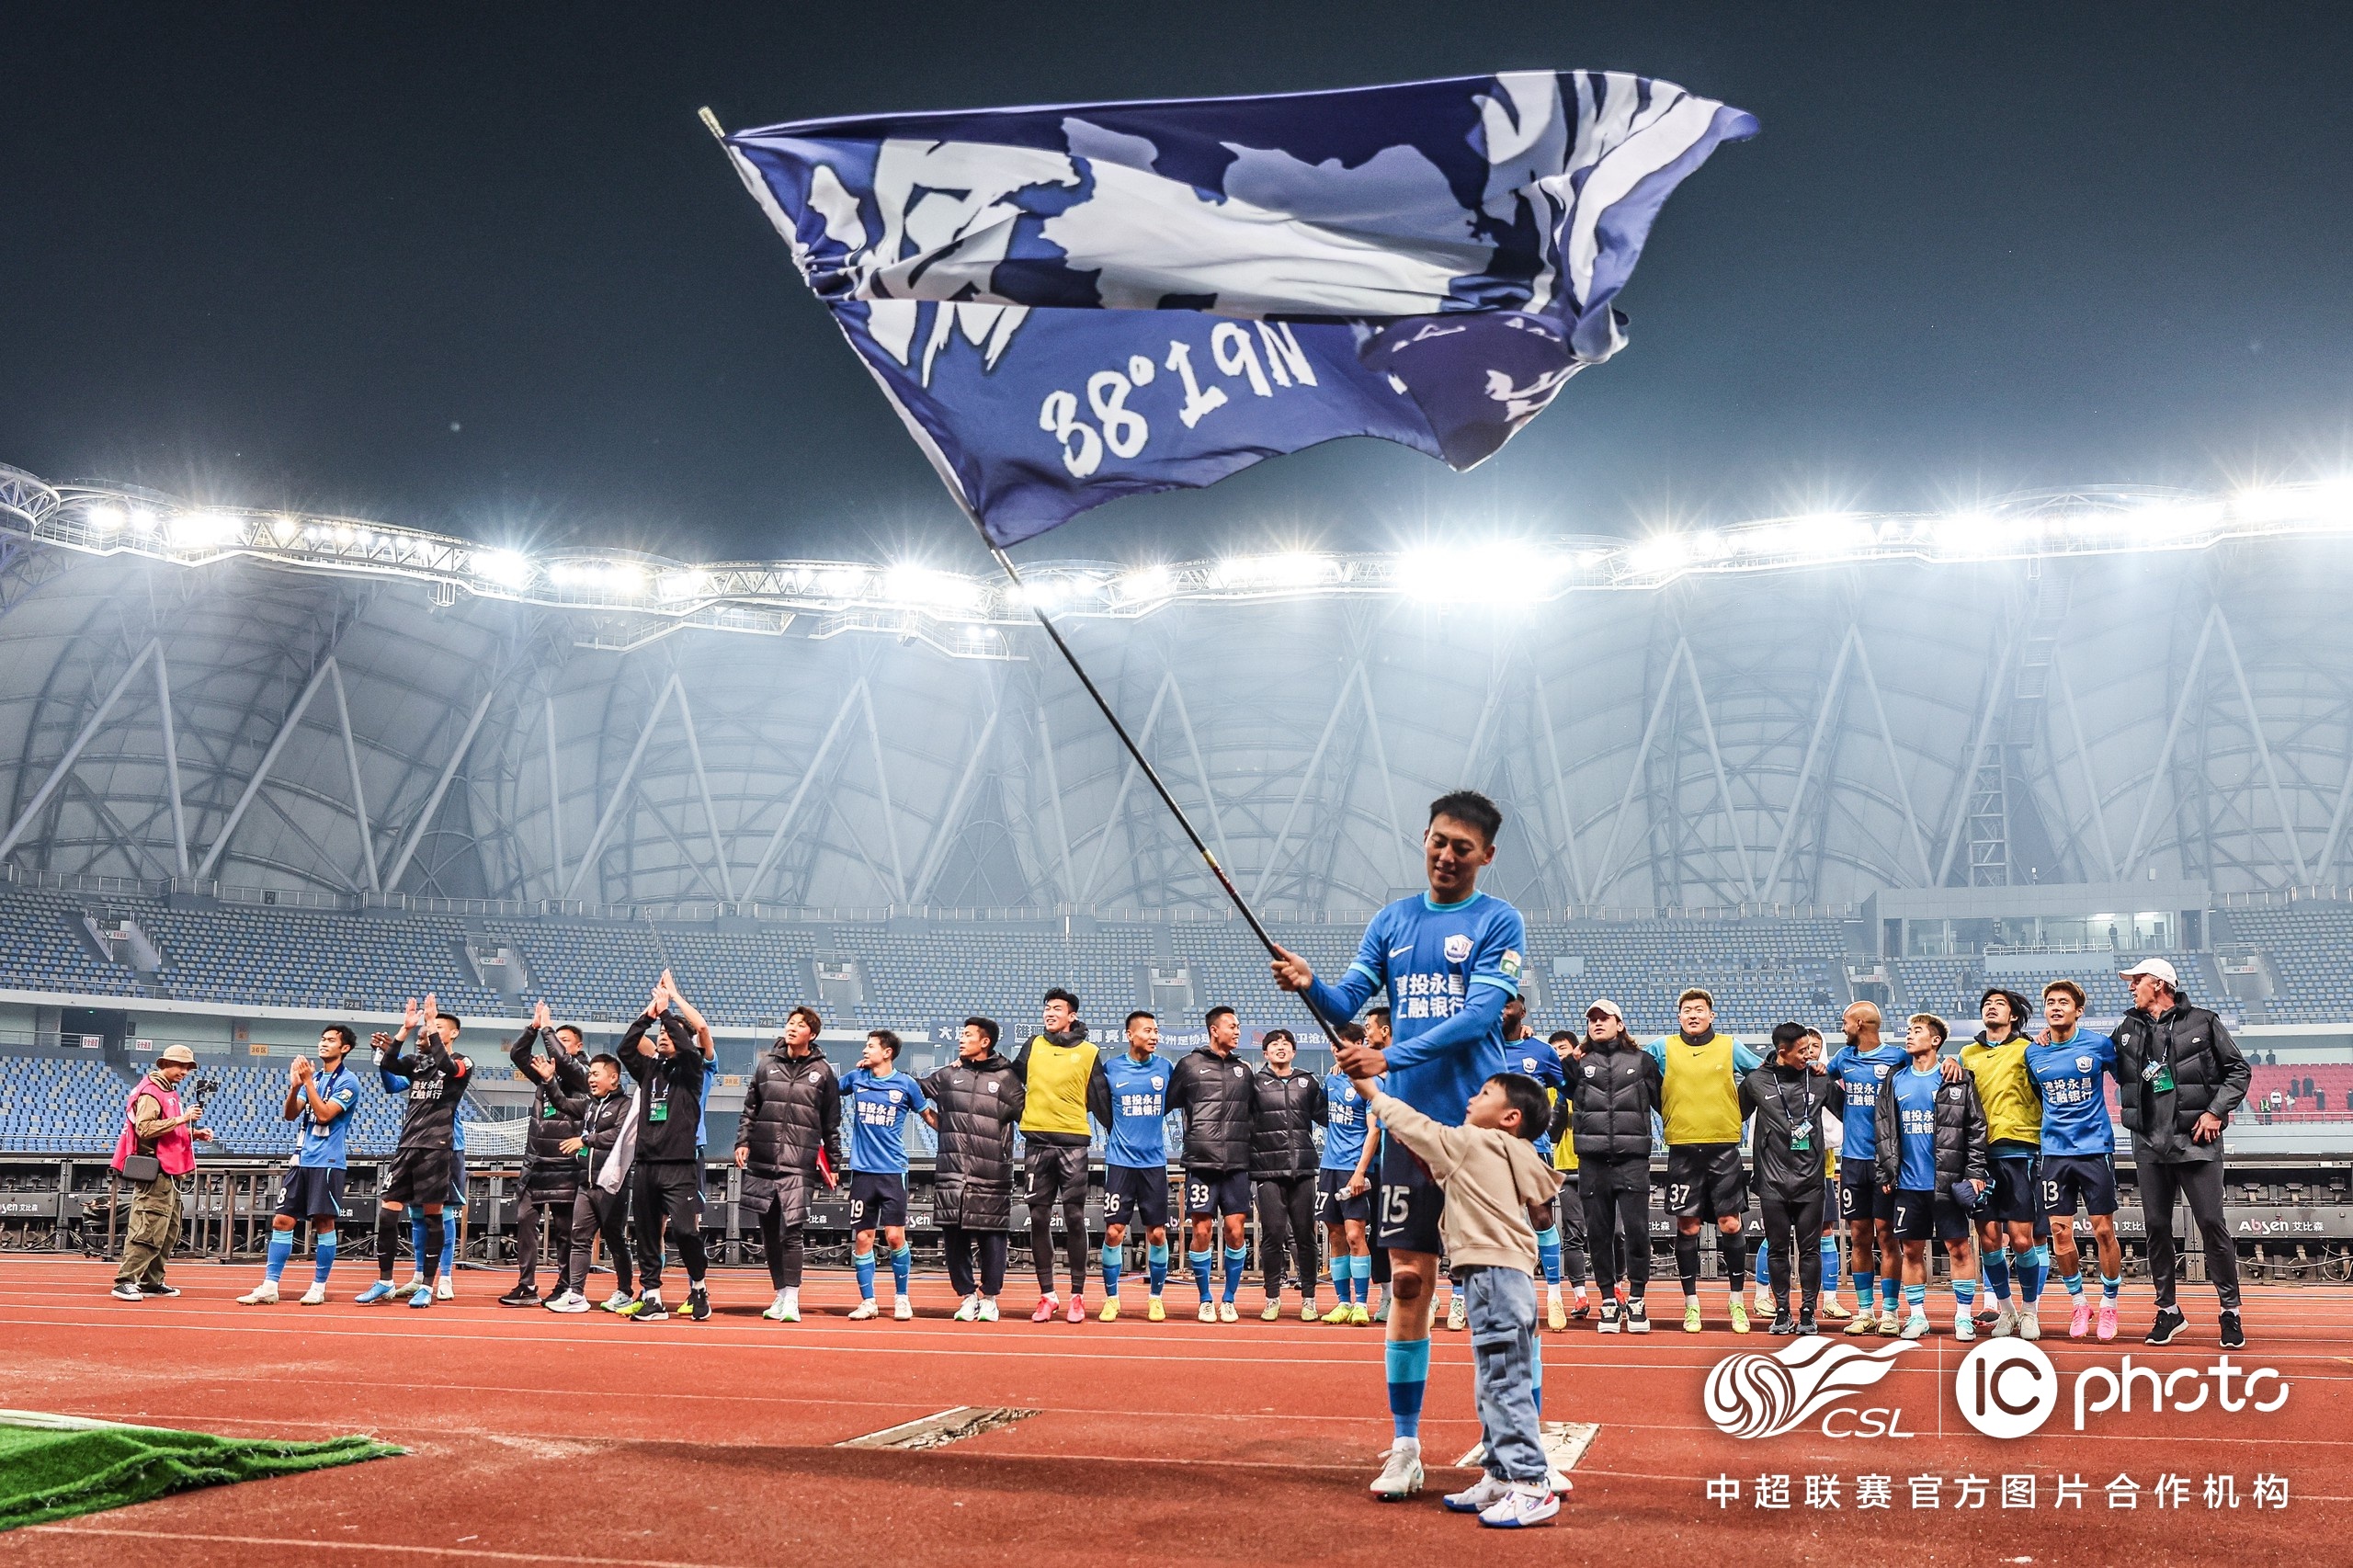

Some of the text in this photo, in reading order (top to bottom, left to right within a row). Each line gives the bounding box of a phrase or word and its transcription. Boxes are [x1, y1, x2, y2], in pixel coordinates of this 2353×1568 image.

[251, 1046, 267, 1054] 36区
[2042, 1077, 2092, 1092] 建投永昌
[1120, 1095, 1162, 1106] 建投永昌
[1847, 1094, 1878, 1106] 汇融银
[2047, 1090, 2094, 1104] 汇融银行
[858, 1101, 897, 1117] 建投永昌
[1122, 1106, 1162, 1117] 汇融银行
[1328, 1101, 1354, 1115] 投永昌
[1028, 1173, 1035, 1192] 1
[2041, 1180, 2059, 1202] 13
[278, 1187, 287, 1204] 8
[1103, 1192, 1121, 1212] 36
[1190, 1184, 1210, 1203] 33
[1314, 1191, 1329, 1210] 27
[1669, 1183, 1690, 1204] 37
[1842, 1188, 1853, 1209] 9
[18, 1204, 39, 1212] 艾比森
[849, 1199, 864, 1218] 19
[1381, 1185, 1411, 1223] 15
[1896, 1206, 1906, 1227] 7
[2072, 1218, 2120, 1232] Abn
[2238, 1218, 2325, 1235] Absen 艾比森
